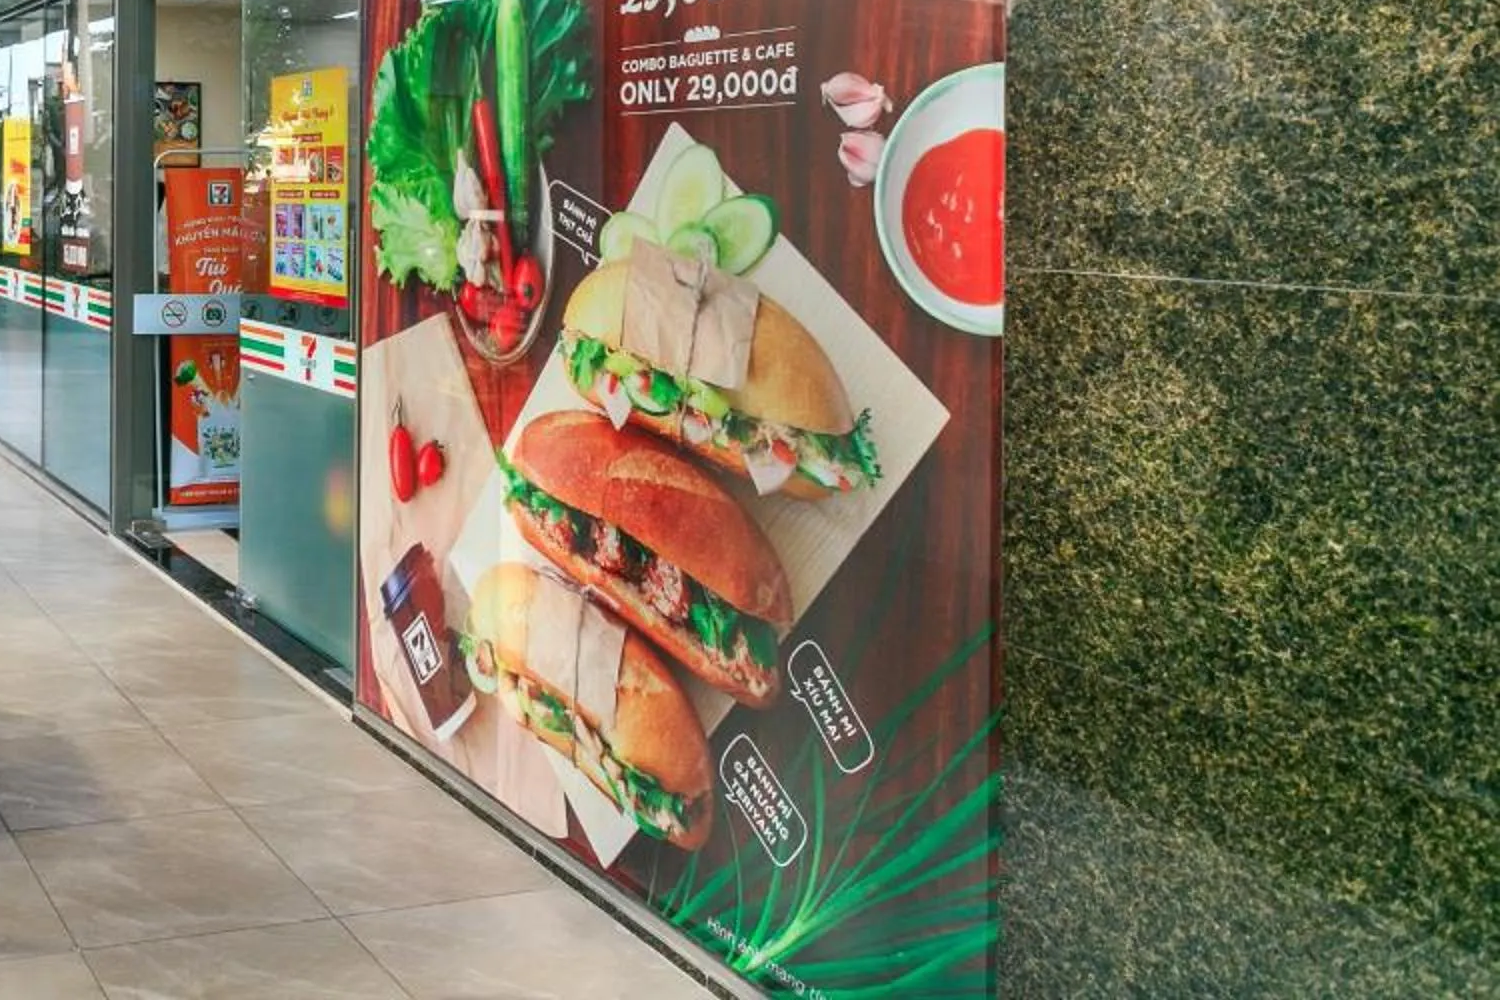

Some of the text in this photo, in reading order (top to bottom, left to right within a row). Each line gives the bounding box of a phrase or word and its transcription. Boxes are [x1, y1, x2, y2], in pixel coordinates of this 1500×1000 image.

[621, 42, 795, 74] COMBO BAGUETTE & CAFE
[620, 65, 799, 105] ONLY 29,000đ
[813, 665, 843, 714] BÁNH
[747, 755, 778, 800] BÁNH
[731, 777, 777, 845] TERIYAKI
